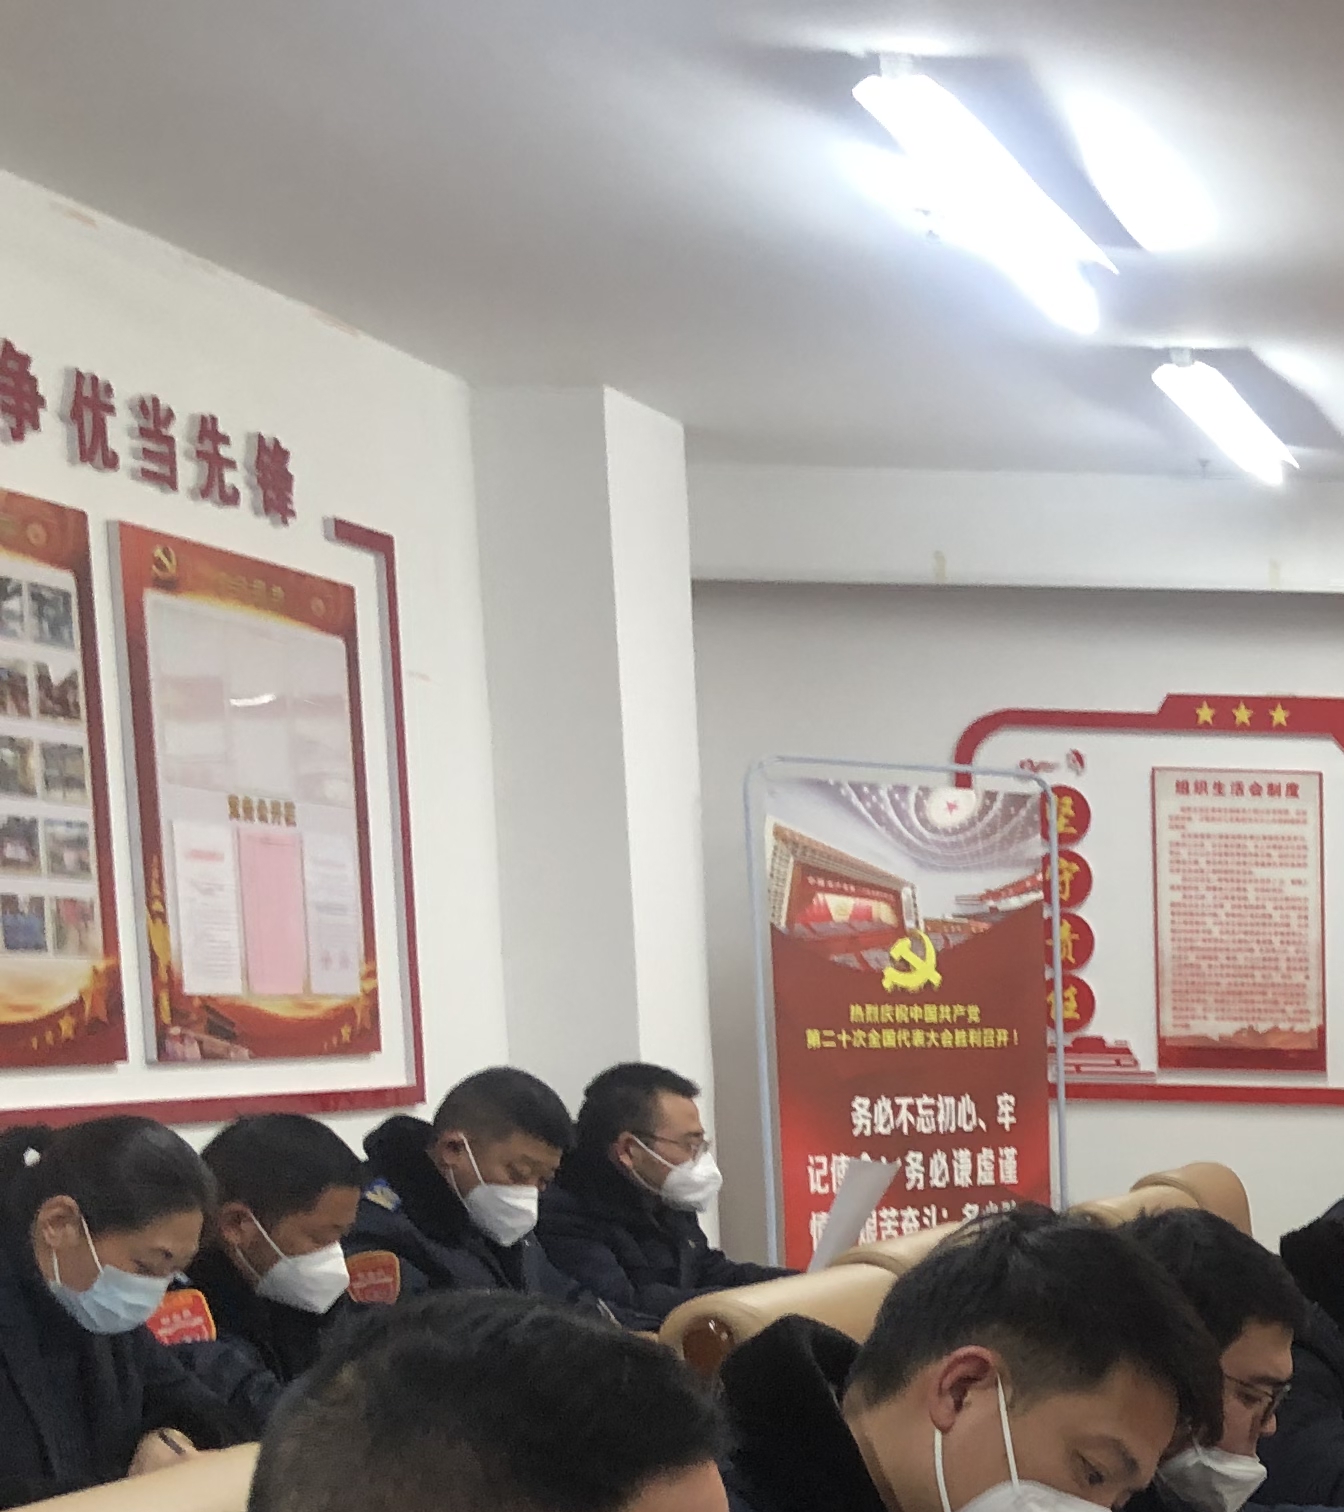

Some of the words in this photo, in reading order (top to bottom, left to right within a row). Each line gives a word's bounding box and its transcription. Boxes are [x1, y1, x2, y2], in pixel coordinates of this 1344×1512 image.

[1175, 779, 1299, 799] 组织生活会制度
[850, 1003, 980, 1024] 热烈庆祝中国共产党
